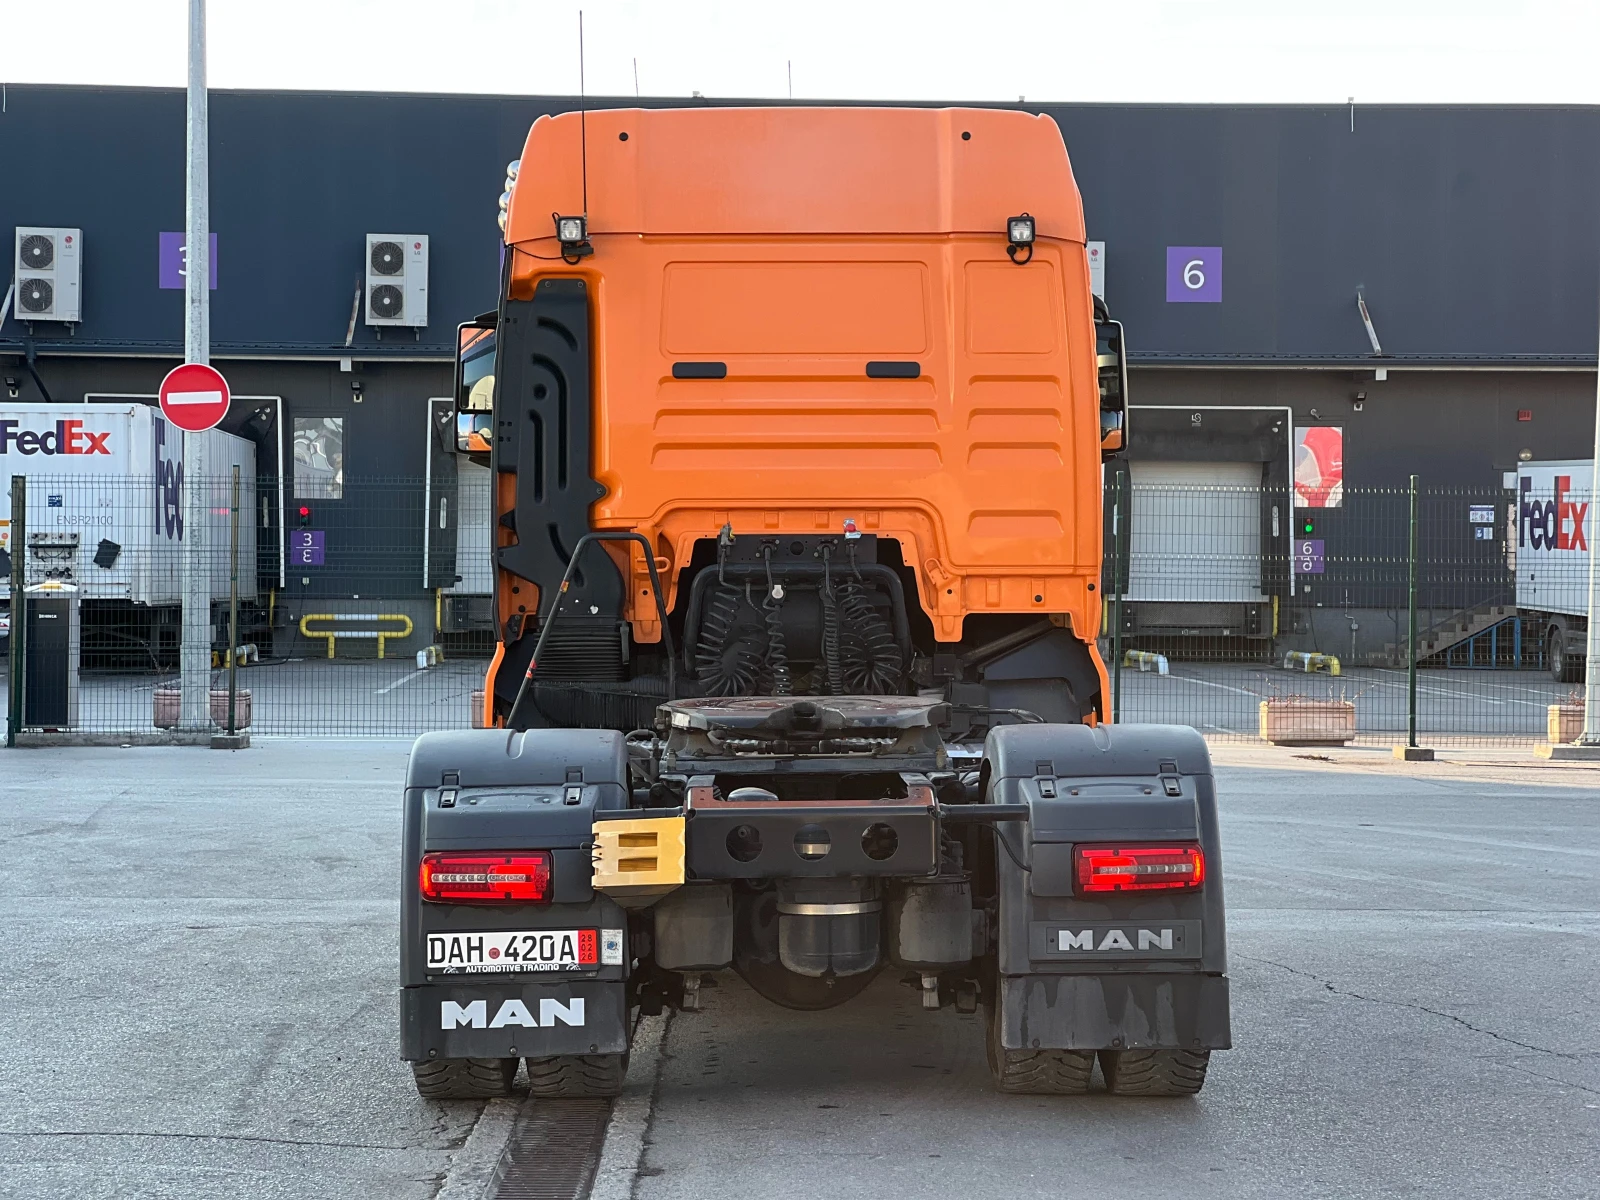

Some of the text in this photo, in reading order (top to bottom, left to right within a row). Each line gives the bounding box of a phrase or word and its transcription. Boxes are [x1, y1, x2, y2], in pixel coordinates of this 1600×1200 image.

[1183, 259, 1205, 289] 6
[0, 419, 111, 456] FedEx
[1519, 475, 1589, 552] FedEx
[303, 533, 312, 546] 3
[1302, 542, 1312, 555] 6
[581, 934, 593, 942] 28
[581, 943, 593, 951] 02
[1058, 928, 1173, 951] MAN
[429, 936, 484, 964] DAH
[504, 934, 576, 962] 420A
[581, 952, 593, 961] 26
[465, 964, 521, 974] AUTOMOTIVE
[522, 962, 560, 972] TRADING
[440, 997, 586, 1030] MAN
